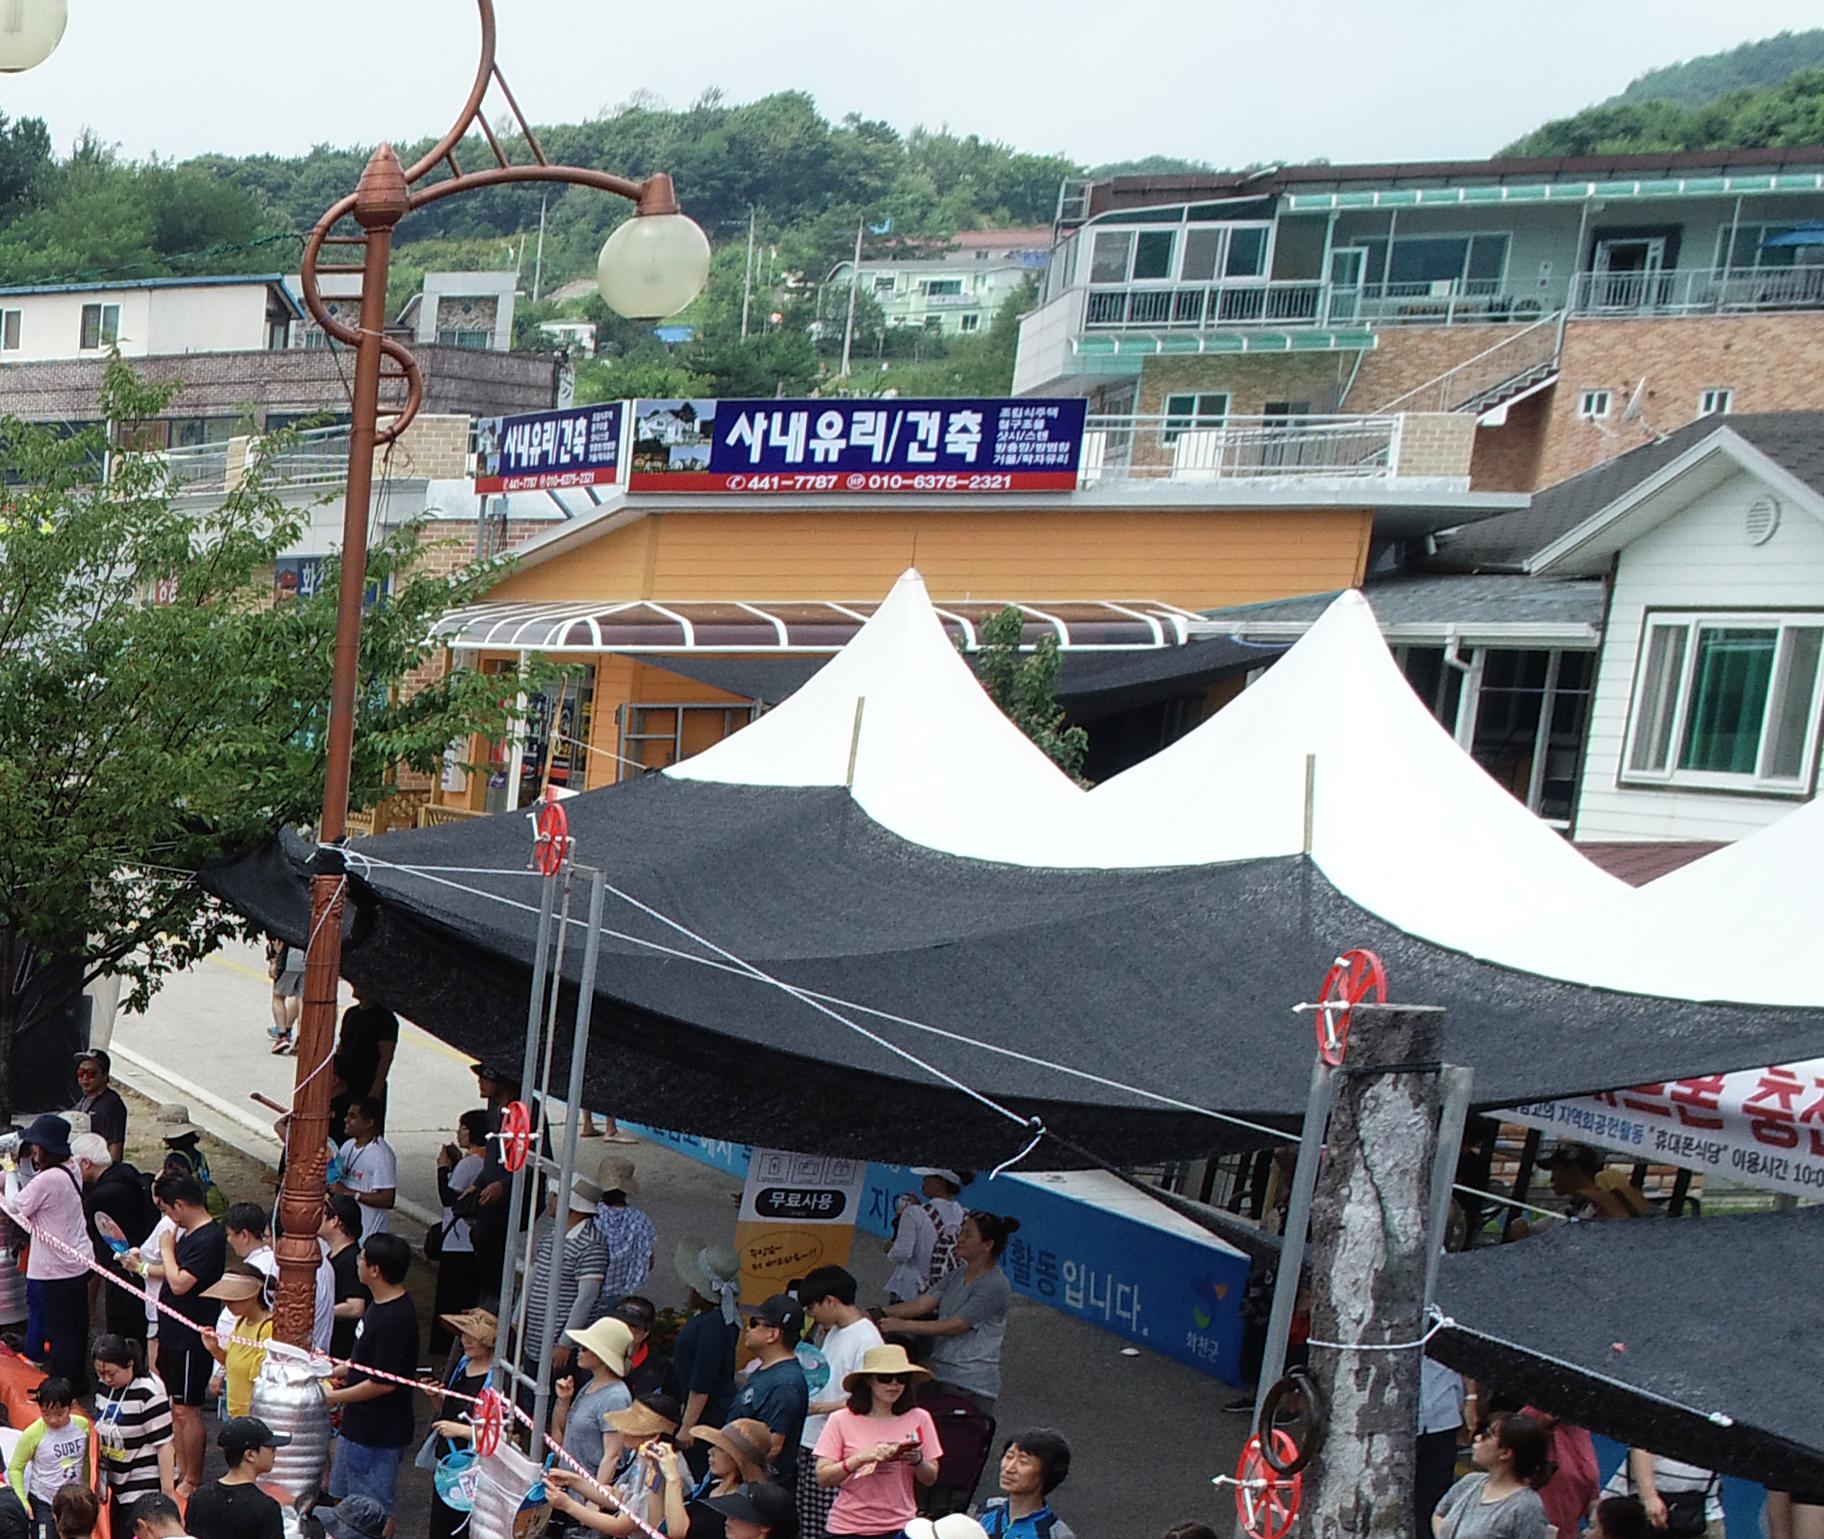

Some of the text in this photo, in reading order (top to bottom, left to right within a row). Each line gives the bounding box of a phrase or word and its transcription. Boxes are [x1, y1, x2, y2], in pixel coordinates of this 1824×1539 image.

[503, 415, 588, 469] 사내유리/건축
[726, 409, 983, 464] 사내유리/건축
[747, 475, 838, 490] 441-7787
[868, 474, 1012, 489] 010-6375-2321
[1731, 1149, 1789, 1181] 이용시간
[768, 1191, 834, 1211] 무료사용
[1185, 1331, 1220, 1363] 화천군
[53, 1438, 81, 1460] SURF
